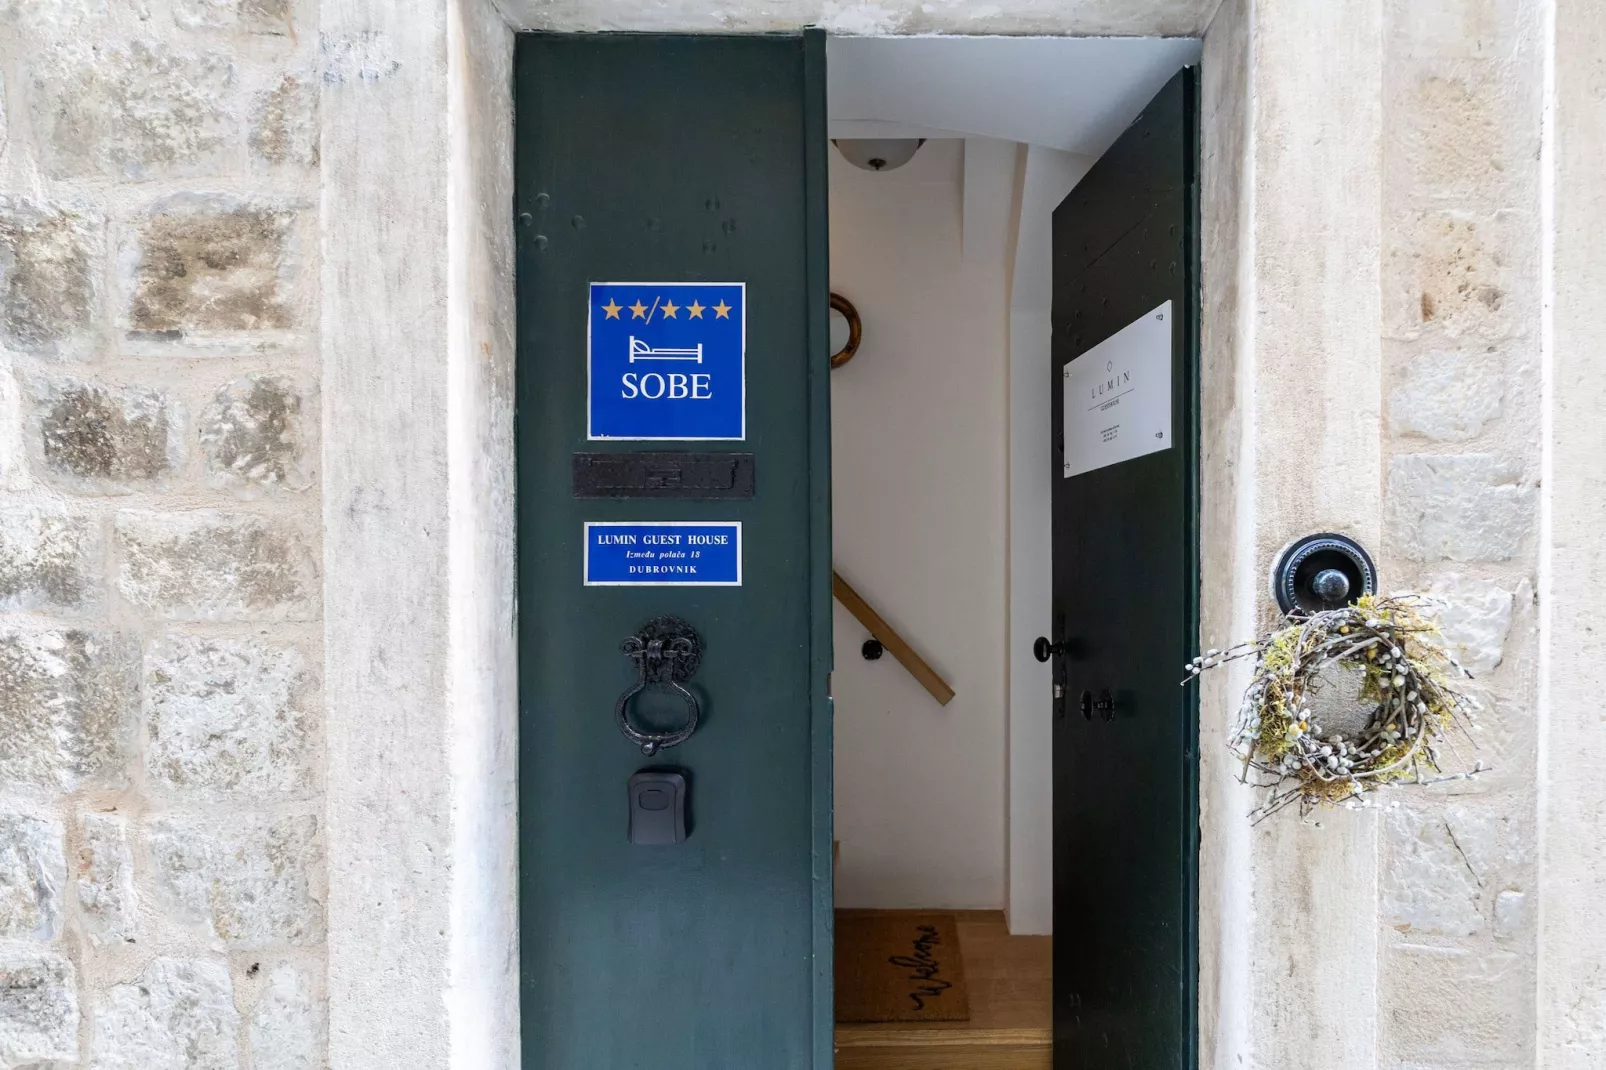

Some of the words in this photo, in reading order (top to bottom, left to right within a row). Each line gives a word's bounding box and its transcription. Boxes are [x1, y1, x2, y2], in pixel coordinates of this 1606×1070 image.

[621, 372, 713, 400] SOBE
[1091, 370, 1130, 399] LUMIN
[597, 534, 637, 545] LUMIN
[642, 534, 682, 545] GUEST
[688, 534, 728, 545] HOUSE
[626, 550, 655, 558] Između
[659, 550, 686, 560] polača
[690, 550, 701, 558] 18
[629, 565, 697, 574] DUBROVNIK
